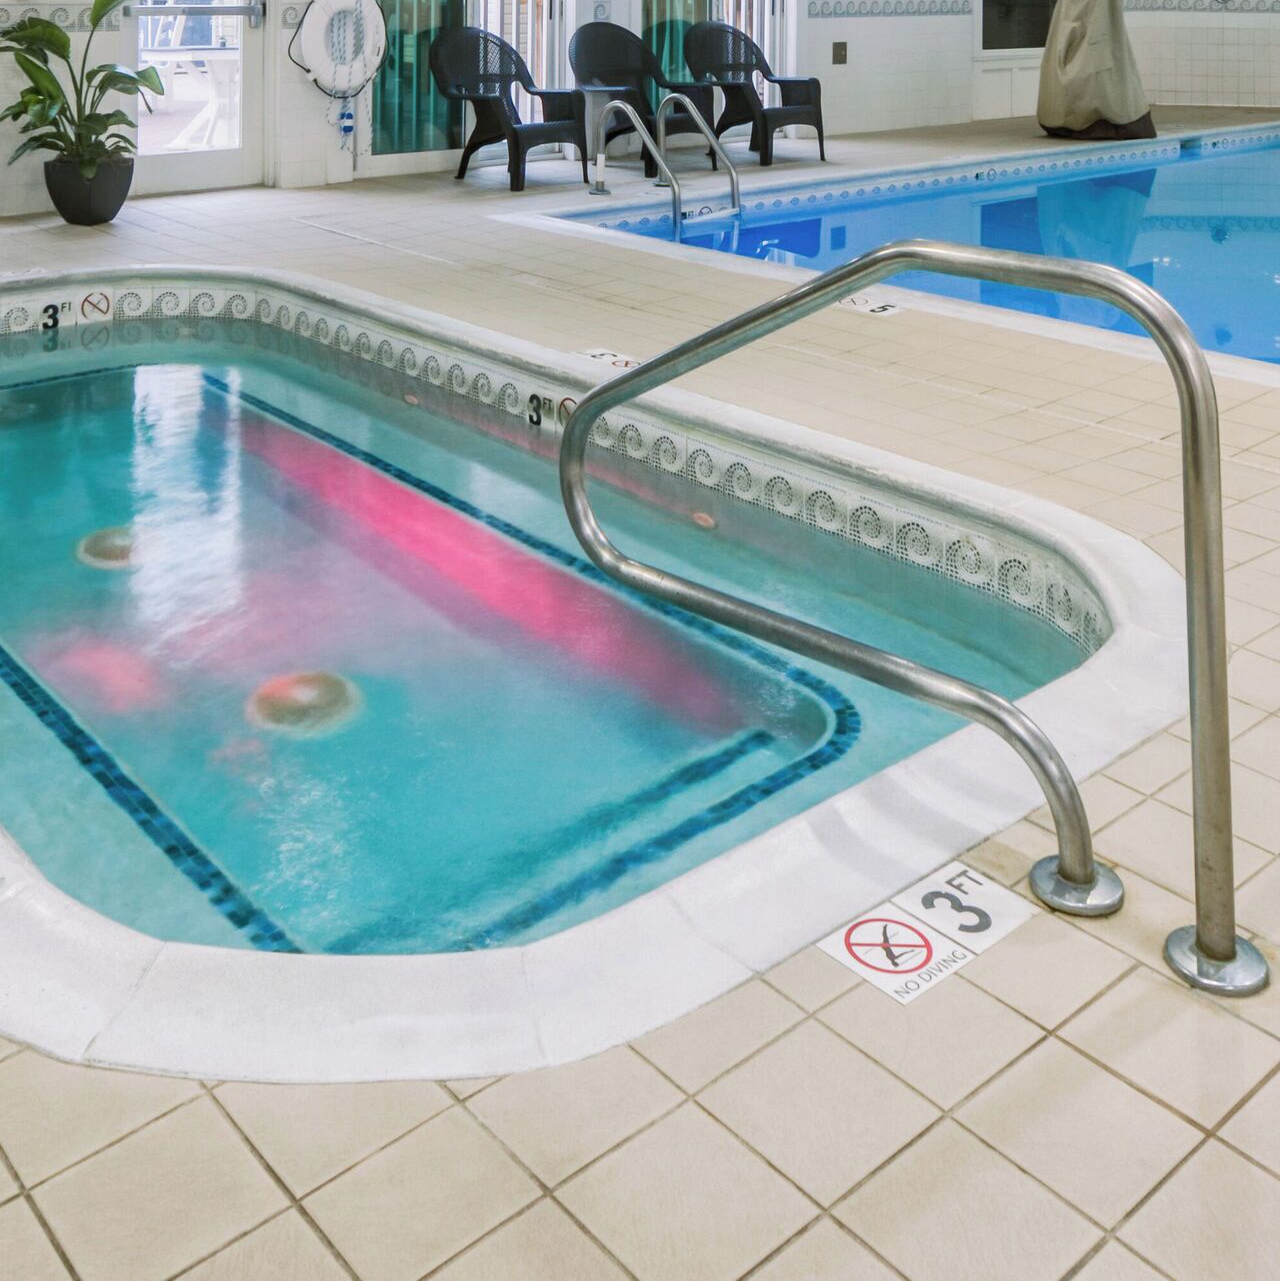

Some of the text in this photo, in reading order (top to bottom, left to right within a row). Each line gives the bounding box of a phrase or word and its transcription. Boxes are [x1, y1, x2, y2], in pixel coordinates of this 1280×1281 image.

[42, 304, 59, 329] 3
[528, 393, 553, 427] 3 FT
[921, 869, 992, 934] 3 FT
[893, 949, 968, 1000] NO DIVING
